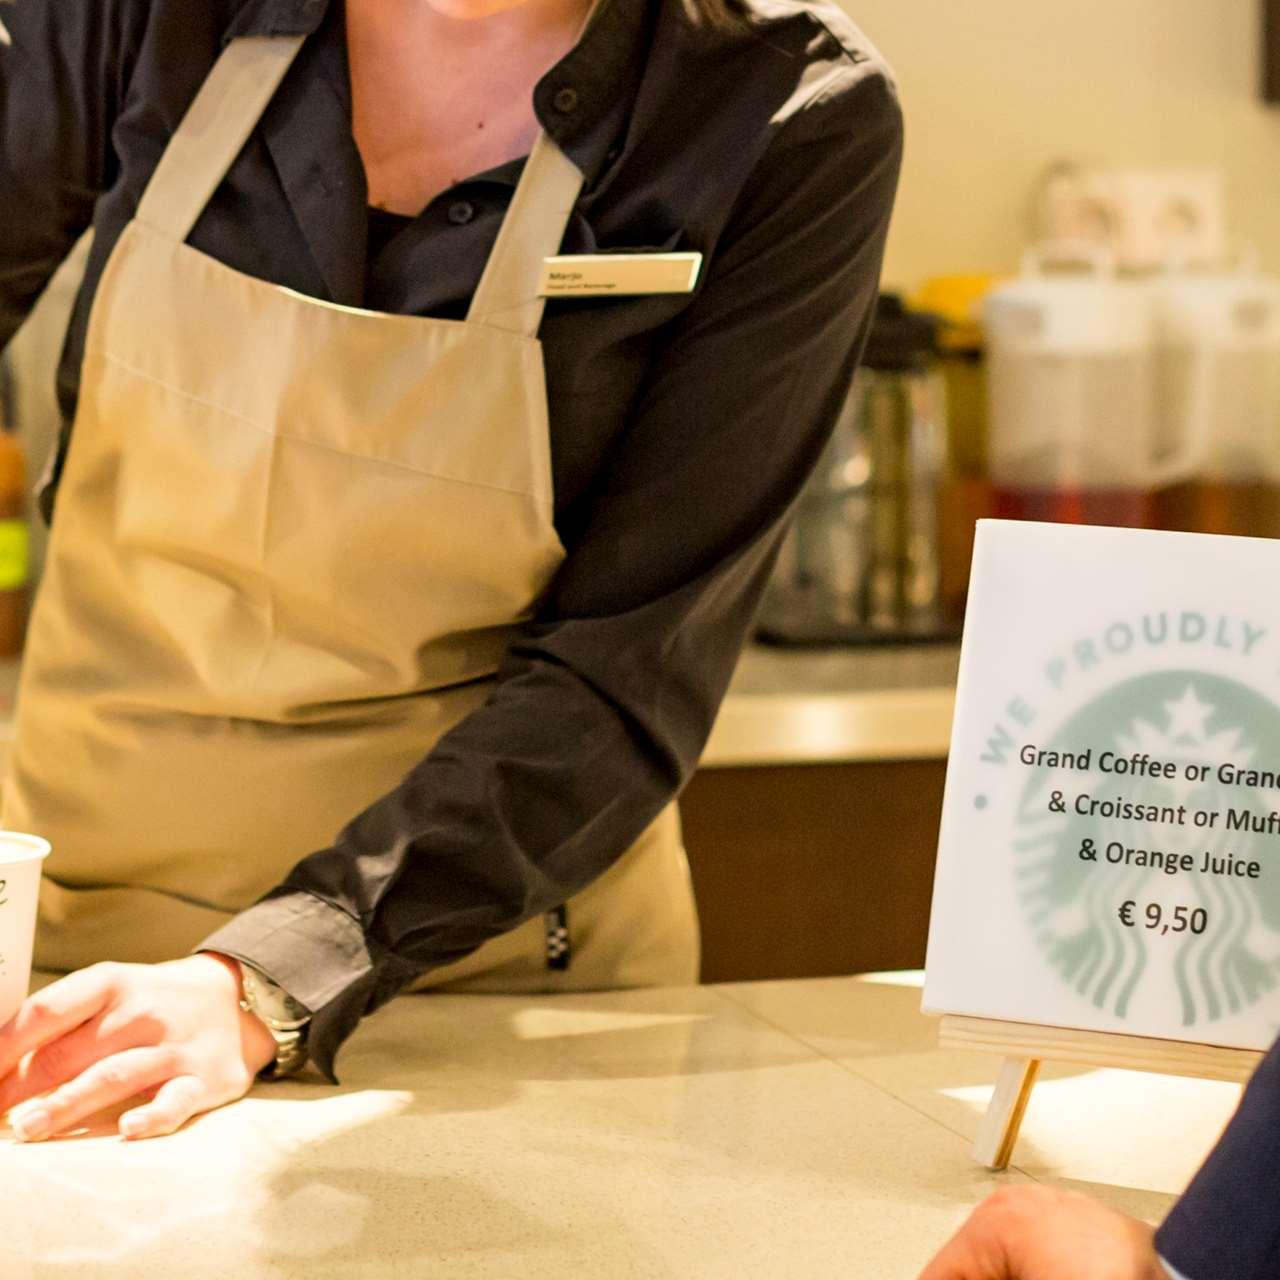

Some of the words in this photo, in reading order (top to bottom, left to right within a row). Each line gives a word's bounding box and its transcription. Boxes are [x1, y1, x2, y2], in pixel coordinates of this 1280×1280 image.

[980, 696, 1036, 767] WE
[1043, 610, 1268, 690] PROUDLY
[1019, 744, 1091, 770] Grand
[1099, 751, 1176, 778] Coffee
[1184, 763, 1209, 782] or
[1048, 791, 1066, 813] &
[1075, 794, 1186, 826] Croissant
[1193, 810, 1219, 828] or
[1078, 838, 1097, 861] &
[1106, 841, 1193, 875] Orange
[1200, 852, 1261, 878] Juice
[1118, 900, 1136, 927] €
[1145, 903, 1208, 935] 9,50
